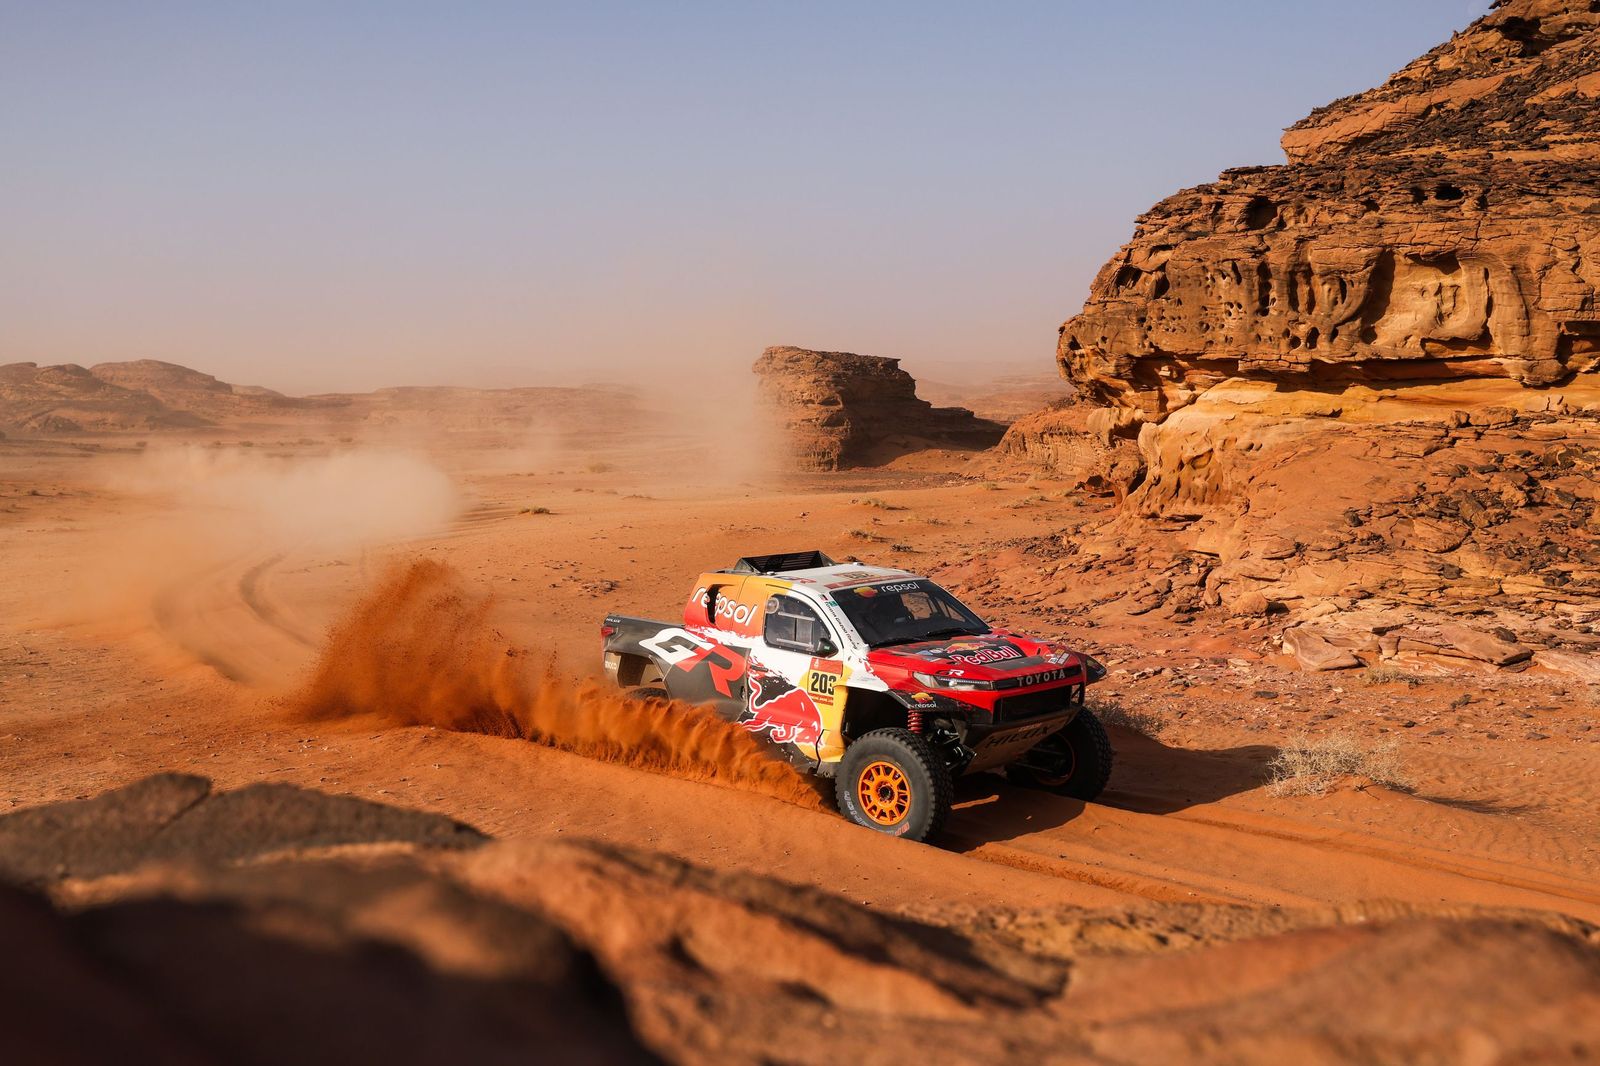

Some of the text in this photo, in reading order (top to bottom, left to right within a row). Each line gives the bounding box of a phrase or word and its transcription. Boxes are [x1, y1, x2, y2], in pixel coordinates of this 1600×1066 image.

[880, 582, 920, 593] repsol
[691, 586, 758, 627] repsol
[950, 645, 1022, 665] Red Bull
[810, 672, 837, 696] 203
[1017, 669, 1066, 687] TOYOTA
[914, 700, 937, 709] repsol
